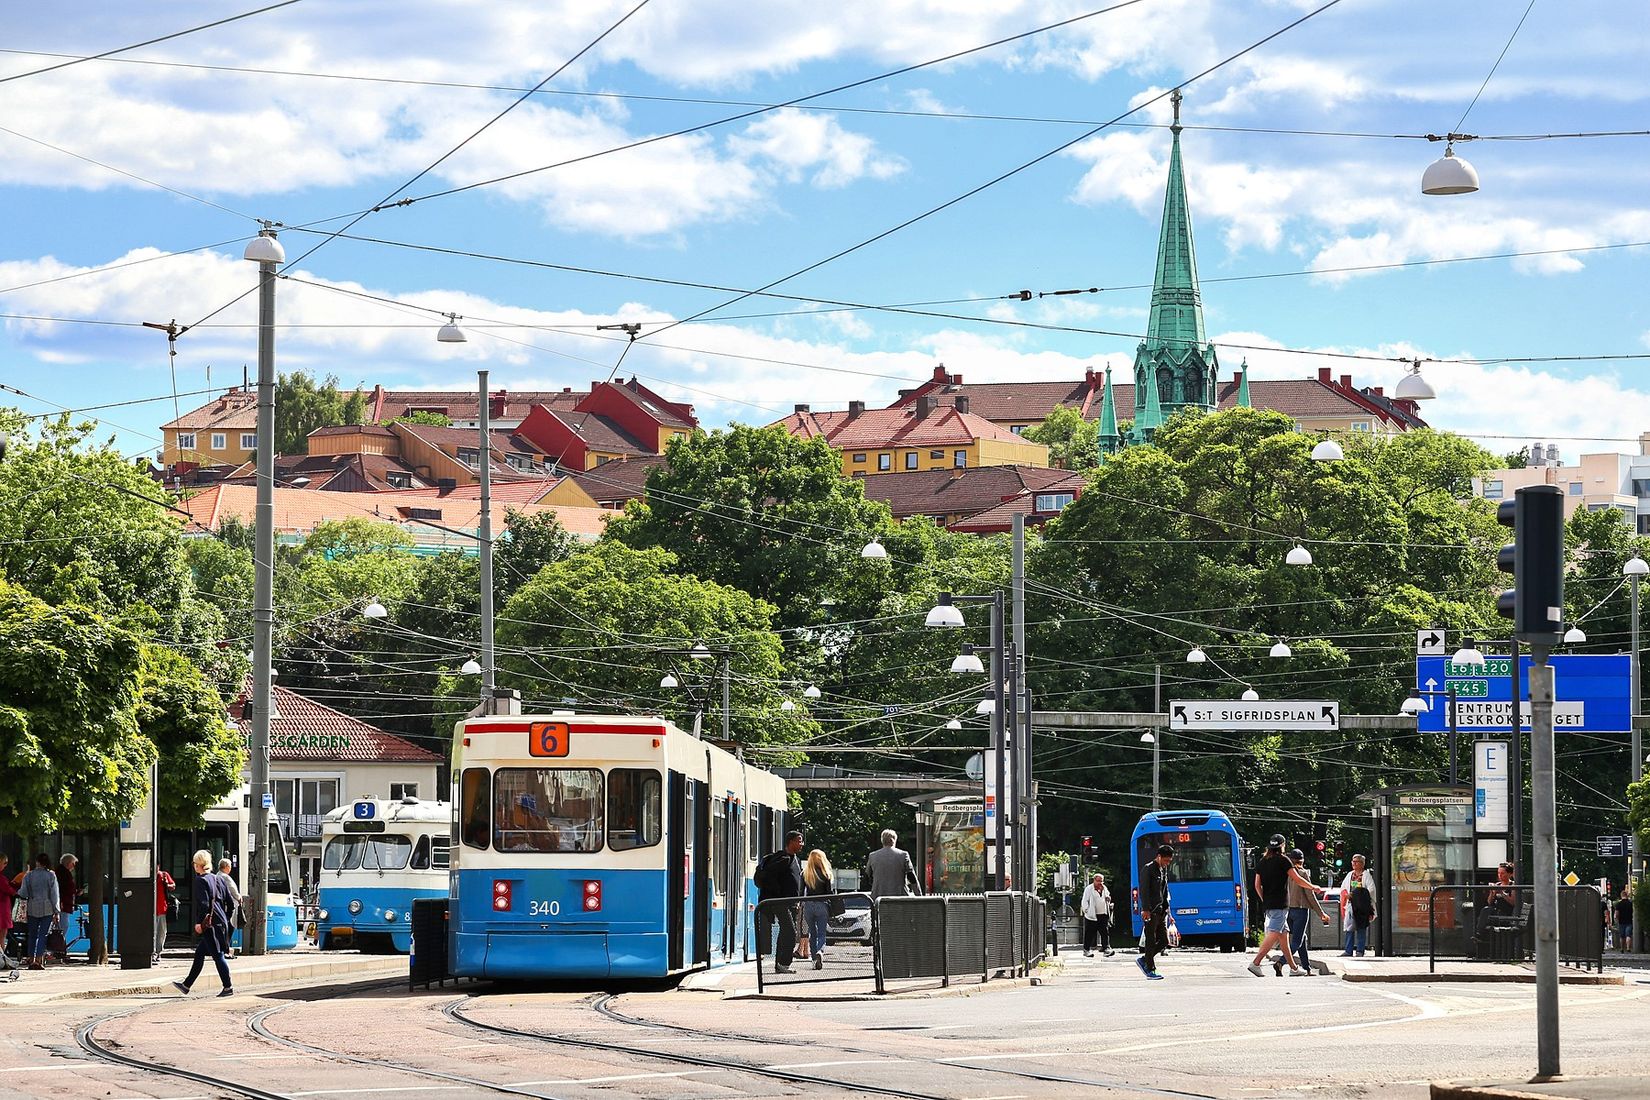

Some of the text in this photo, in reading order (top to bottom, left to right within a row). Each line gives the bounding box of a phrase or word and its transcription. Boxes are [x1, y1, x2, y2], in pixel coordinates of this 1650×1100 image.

[1451, 664, 1509, 673] E6 E20
[1453, 683, 1479, 693] E45
[885, 705, 899, 713] 701
[1448, 703, 1513, 713] ENTRUM
[1194, 711, 1315, 721] S:T SIGFRIDSPLAN
[541, 725, 558, 753] 6
[1486, 748, 1497, 770] E
[1409, 797, 1464, 805] Redbergsplatsen
[360, 803, 368, 816] 3
[529, 901, 560, 916] 340
